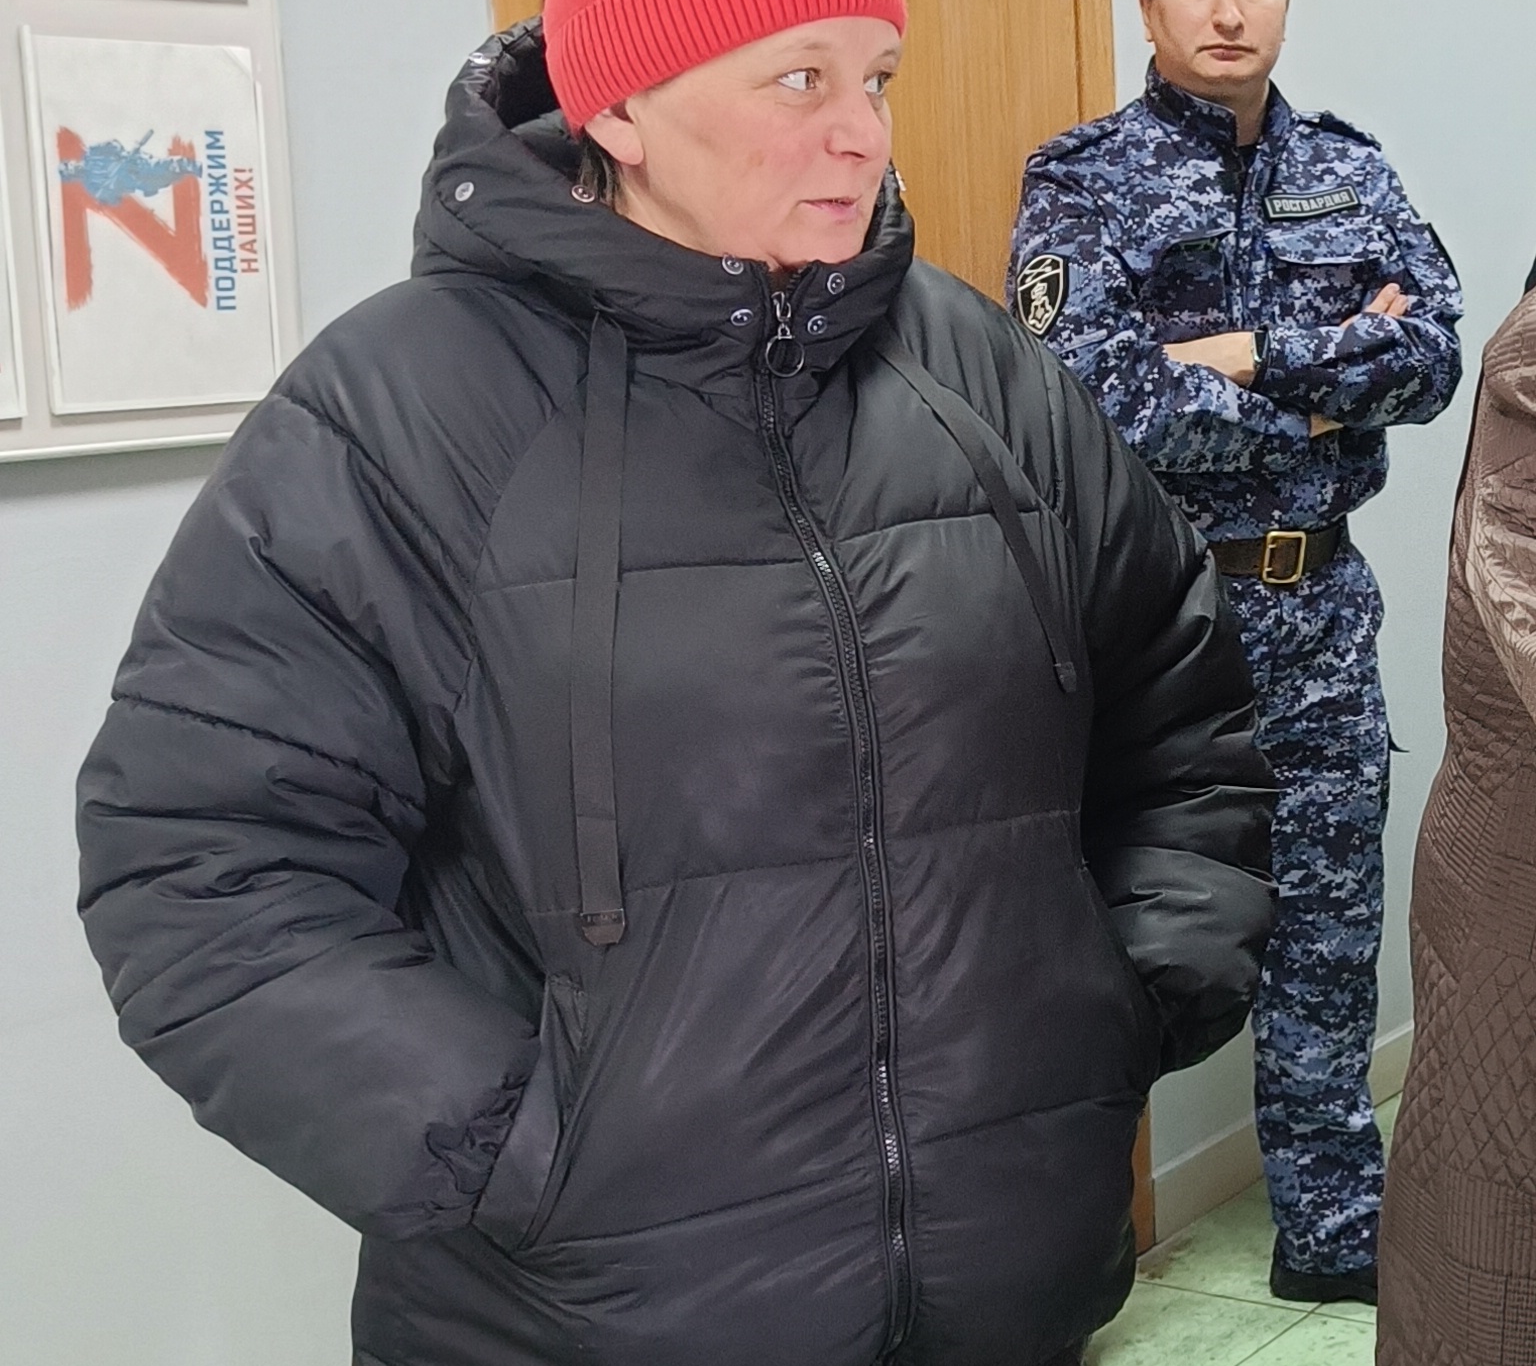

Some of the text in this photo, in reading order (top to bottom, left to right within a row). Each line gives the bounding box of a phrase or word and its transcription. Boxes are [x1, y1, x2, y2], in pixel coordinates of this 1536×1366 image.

[204, 129, 238, 311] ПОДДЕРЖИМ
[233, 167, 260, 274] НАШИХ!
[1272, 191, 1351, 213] РОСГВАРДИЯ
